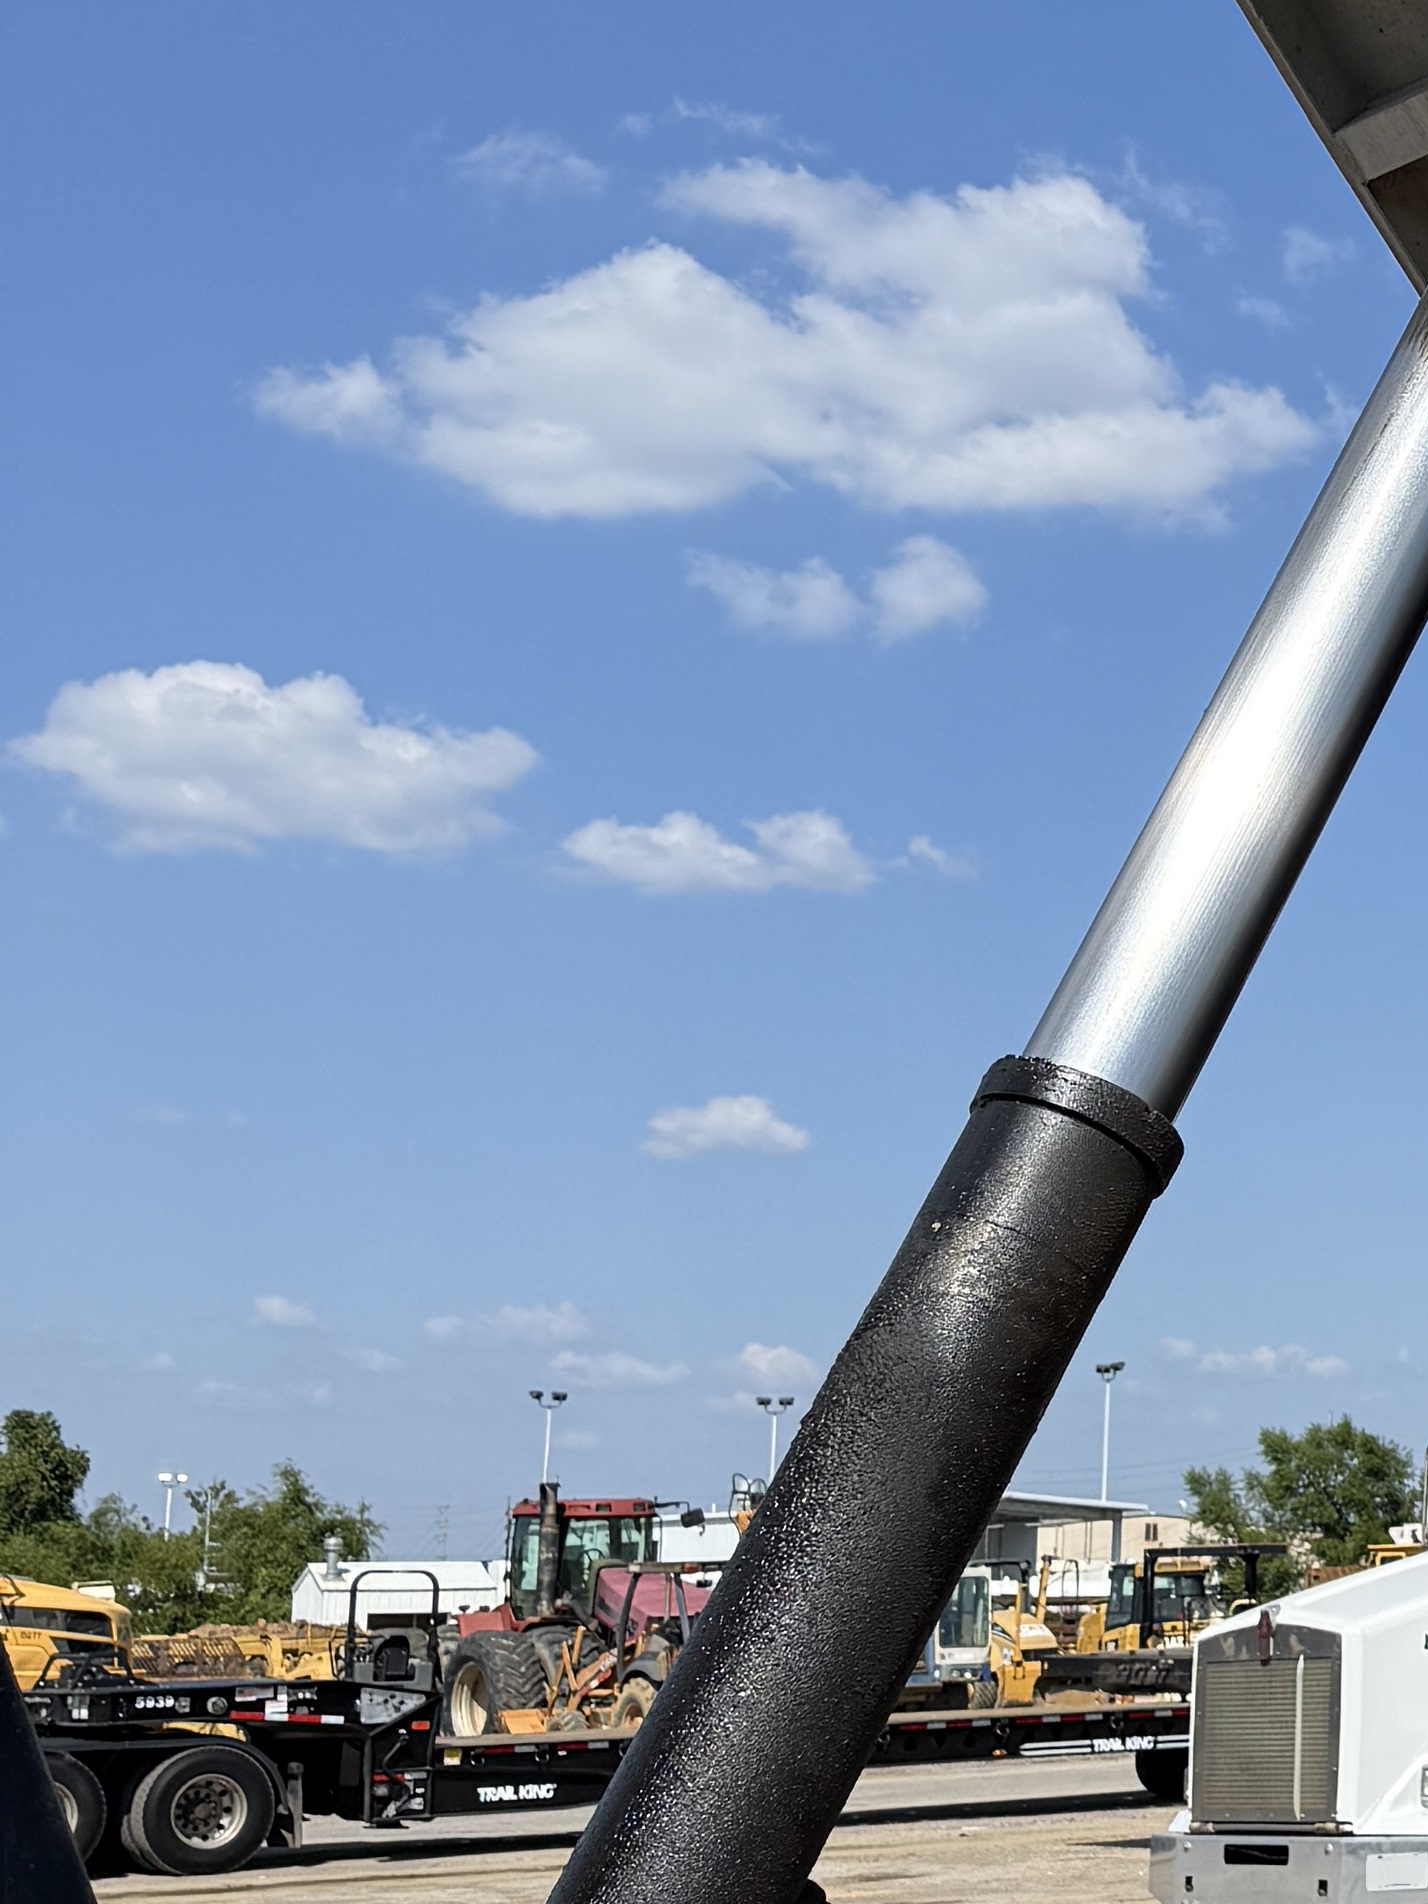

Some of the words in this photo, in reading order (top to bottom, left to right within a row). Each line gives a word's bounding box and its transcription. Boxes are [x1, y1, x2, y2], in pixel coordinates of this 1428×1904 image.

[135, 1696, 175, 1709] 5939
[1092, 1736, 1126, 1753] TRAIL
[1126, 1734, 1155, 1751] KING
[477, 1785, 518, 1803] TRAIL
[518, 1783, 554, 1800] KING
